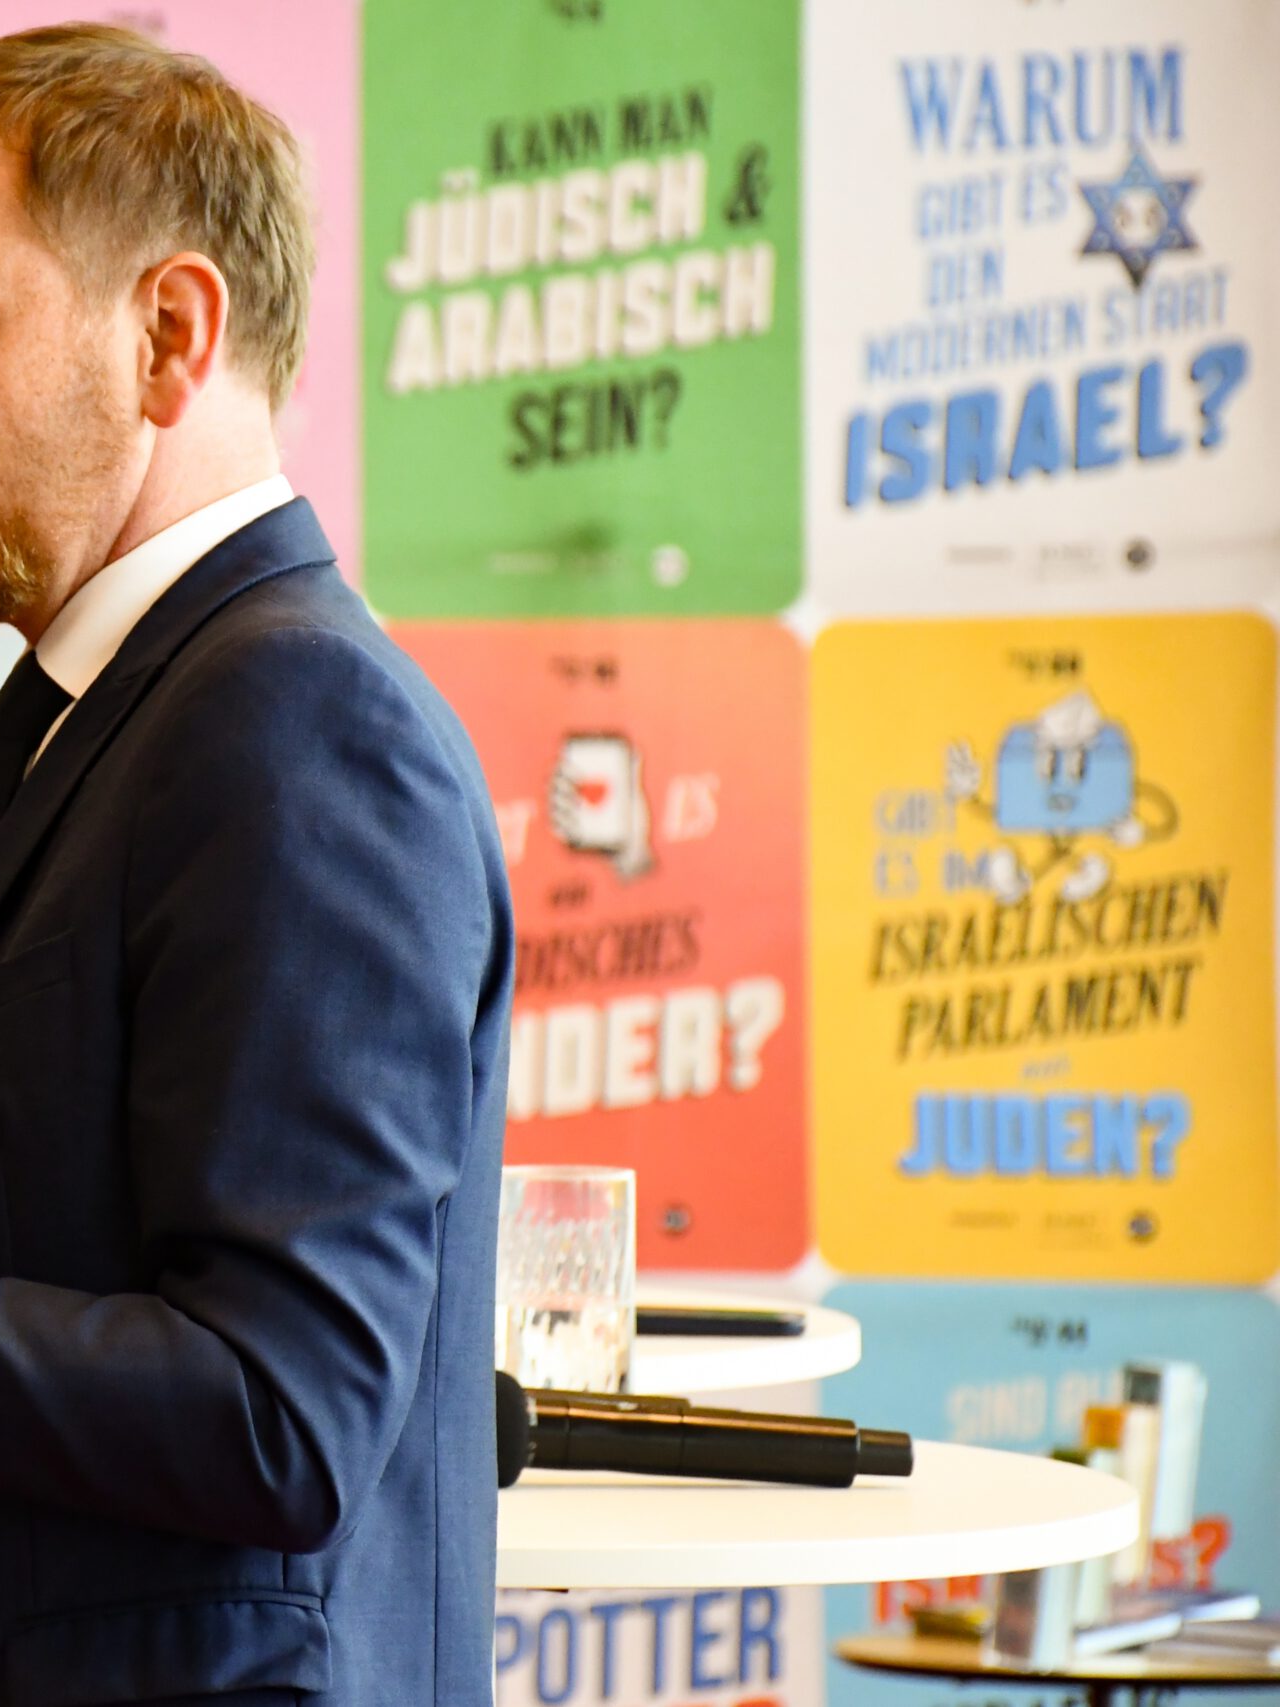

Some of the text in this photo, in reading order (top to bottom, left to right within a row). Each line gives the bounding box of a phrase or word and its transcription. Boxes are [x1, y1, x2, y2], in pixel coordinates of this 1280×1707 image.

[617, 80, 712, 153] MAN
[897, 45, 1186, 152] WARUM
[386, 152, 708, 292] JÜDISCH
[1017, 160, 1071, 226] ES
[387, 242, 776, 394] ARABISCH
[1101, 266, 1231, 348] STAAT
[507, 367, 684, 471] SEIN?
[842, 338, 1253, 512] ISRAEL?
[516, 908, 703, 994] DISCHES
[868, 866, 1229, 986] ISRAELISCHEN
[507, 975, 785, 1121] NDER?
[897, 952, 1205, 1064] PARLAMENT
[898, 1090, 1192, 1181] JUDEN?
[496, 1588, 784, 1706] POTTER
